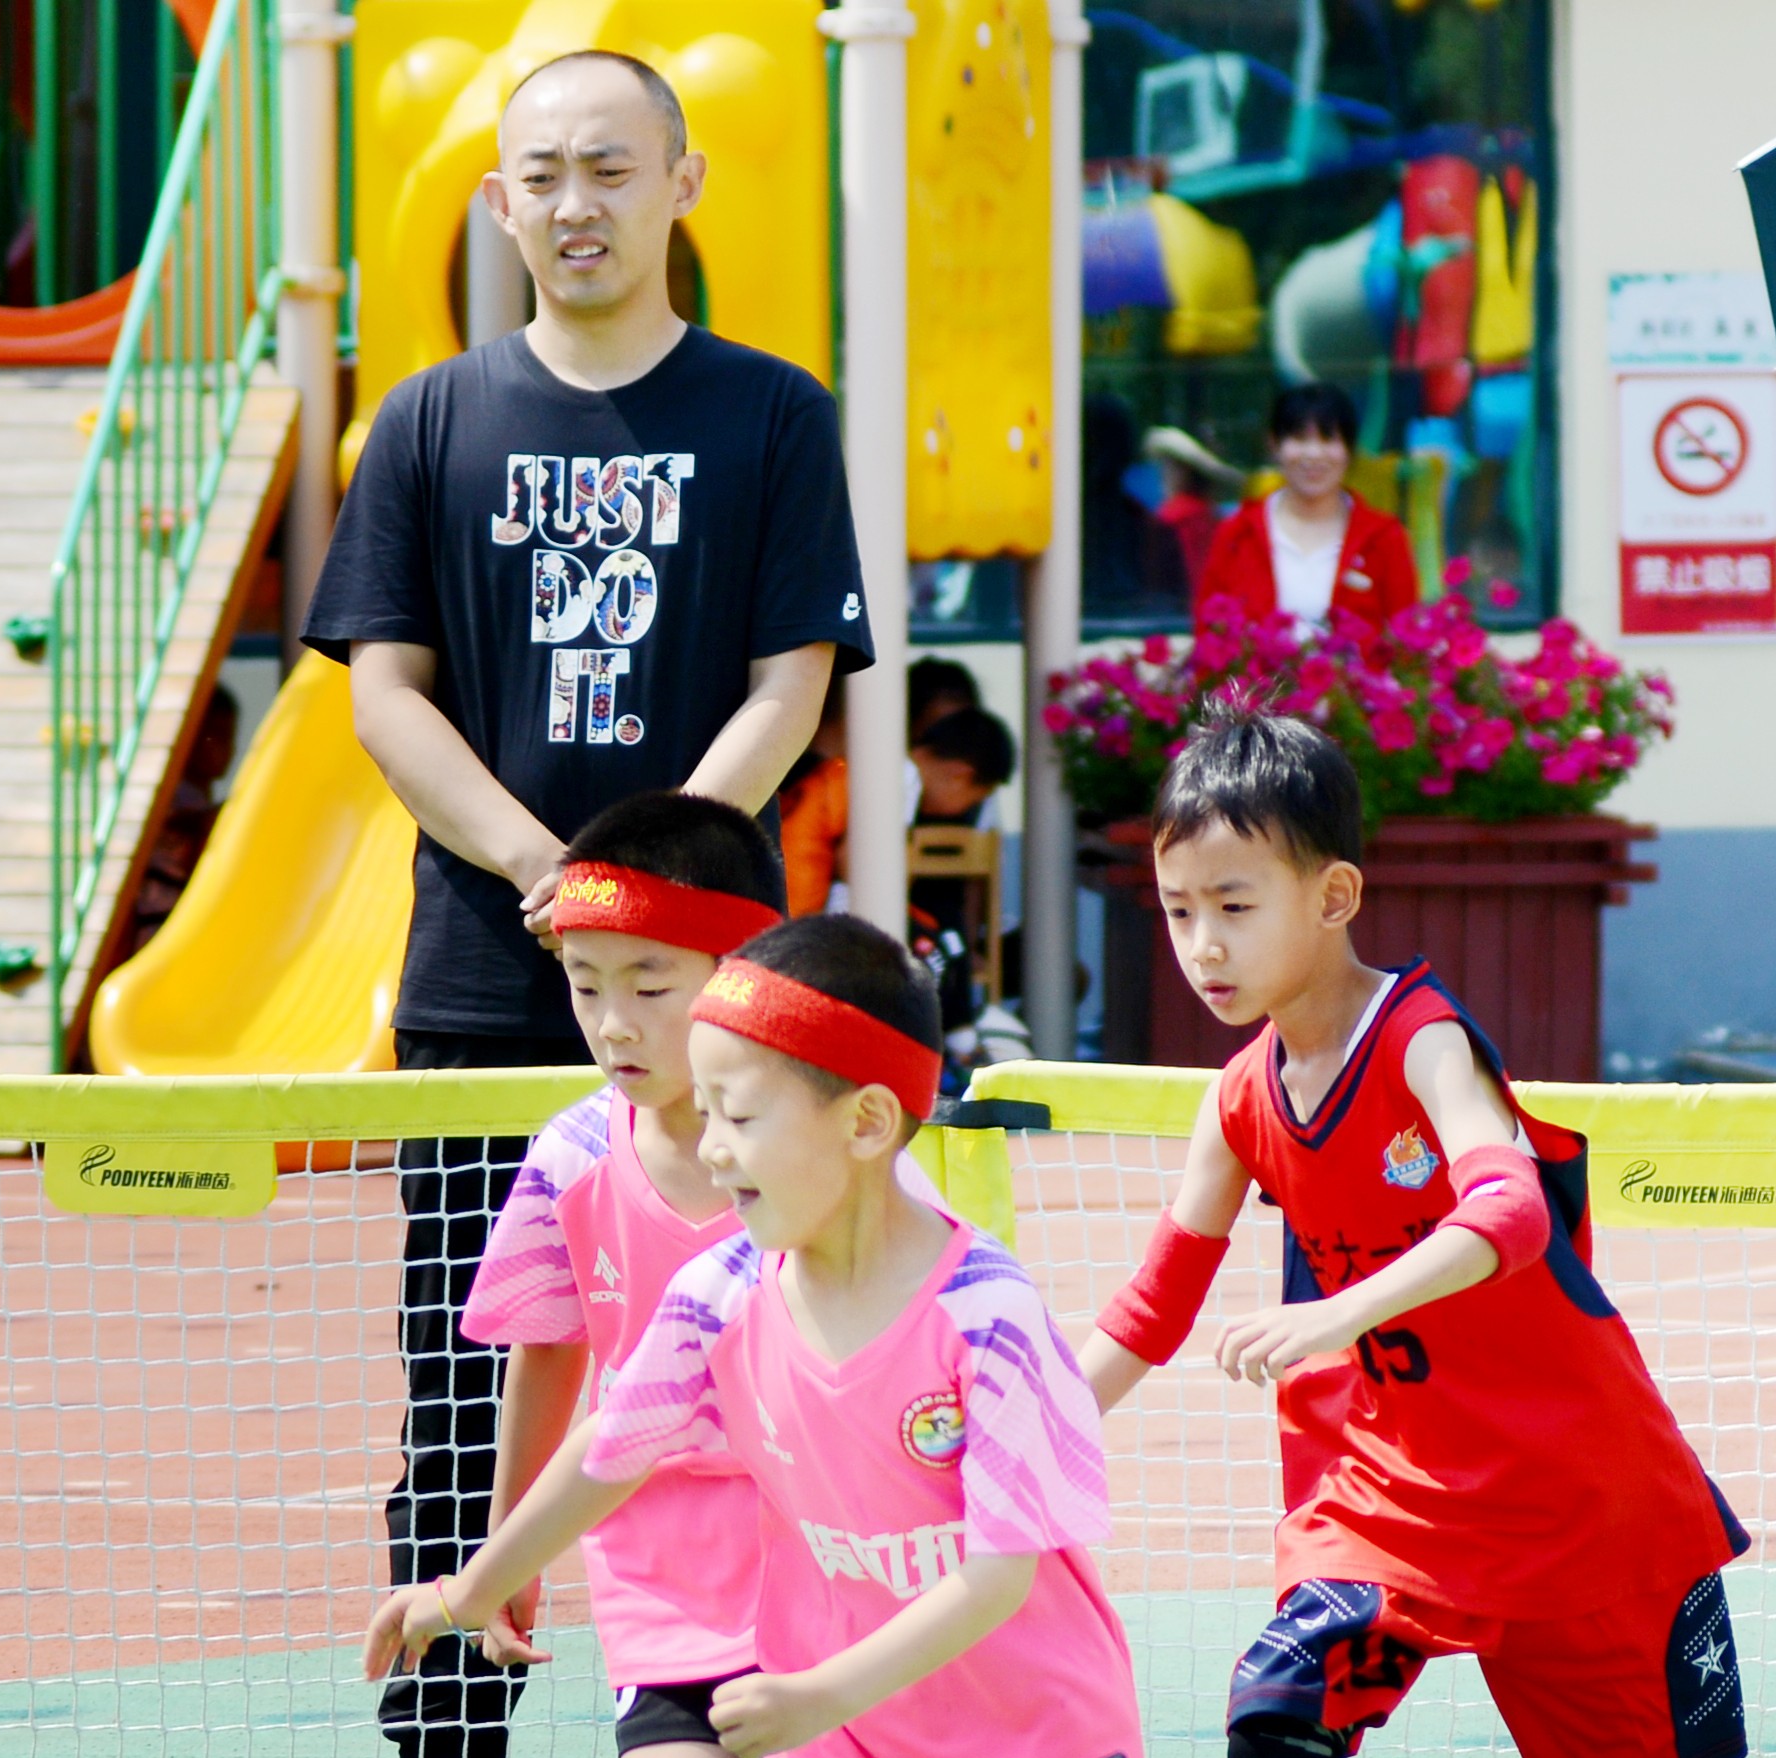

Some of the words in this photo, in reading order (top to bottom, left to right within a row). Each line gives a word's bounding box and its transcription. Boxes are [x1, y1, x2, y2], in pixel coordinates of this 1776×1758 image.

[491, 453, 695, 547] JUST
[530, 549, 658, 645] DO
[548, 648, 645, 746] IT.
[100, 1169, 175, 1188] PODIYEEN
[1642, 1185, 1718, 1203] PODIYEEN
